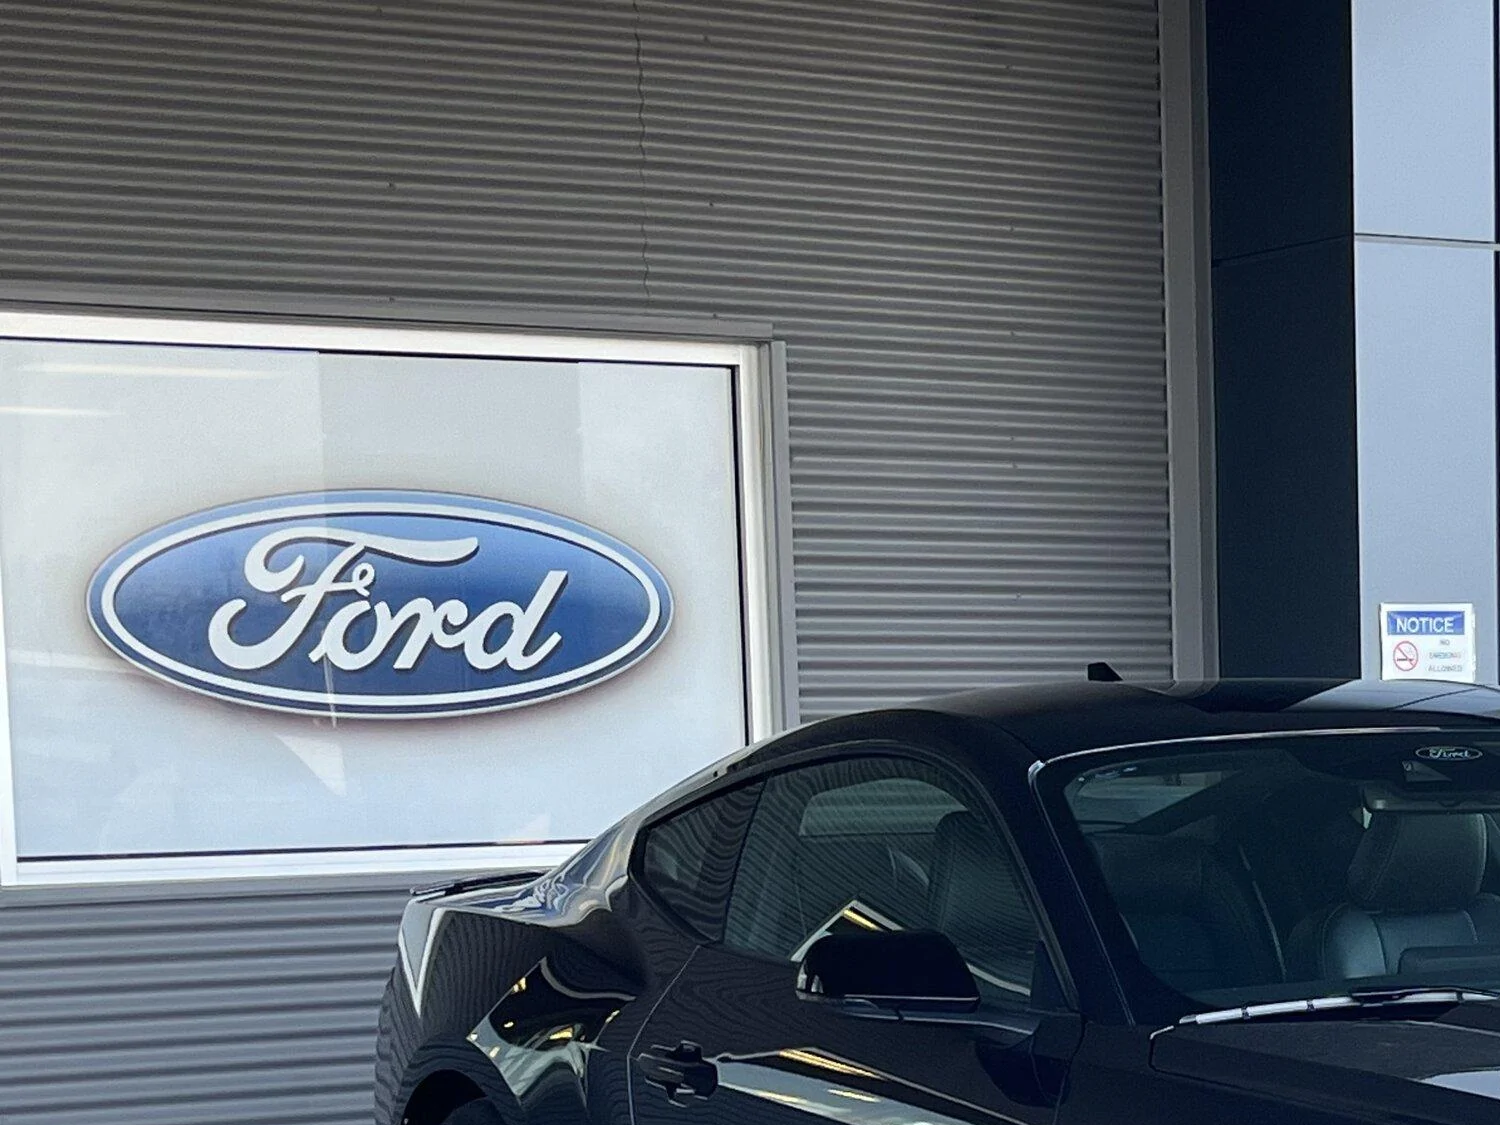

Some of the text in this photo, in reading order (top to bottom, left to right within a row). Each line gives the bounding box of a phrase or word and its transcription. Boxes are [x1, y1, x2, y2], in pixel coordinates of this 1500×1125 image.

[207, 526, 570, 671] Ford
[1396, 616, 1454, 633] NOTICE
[1430, 747, 1469, 758] Ford
